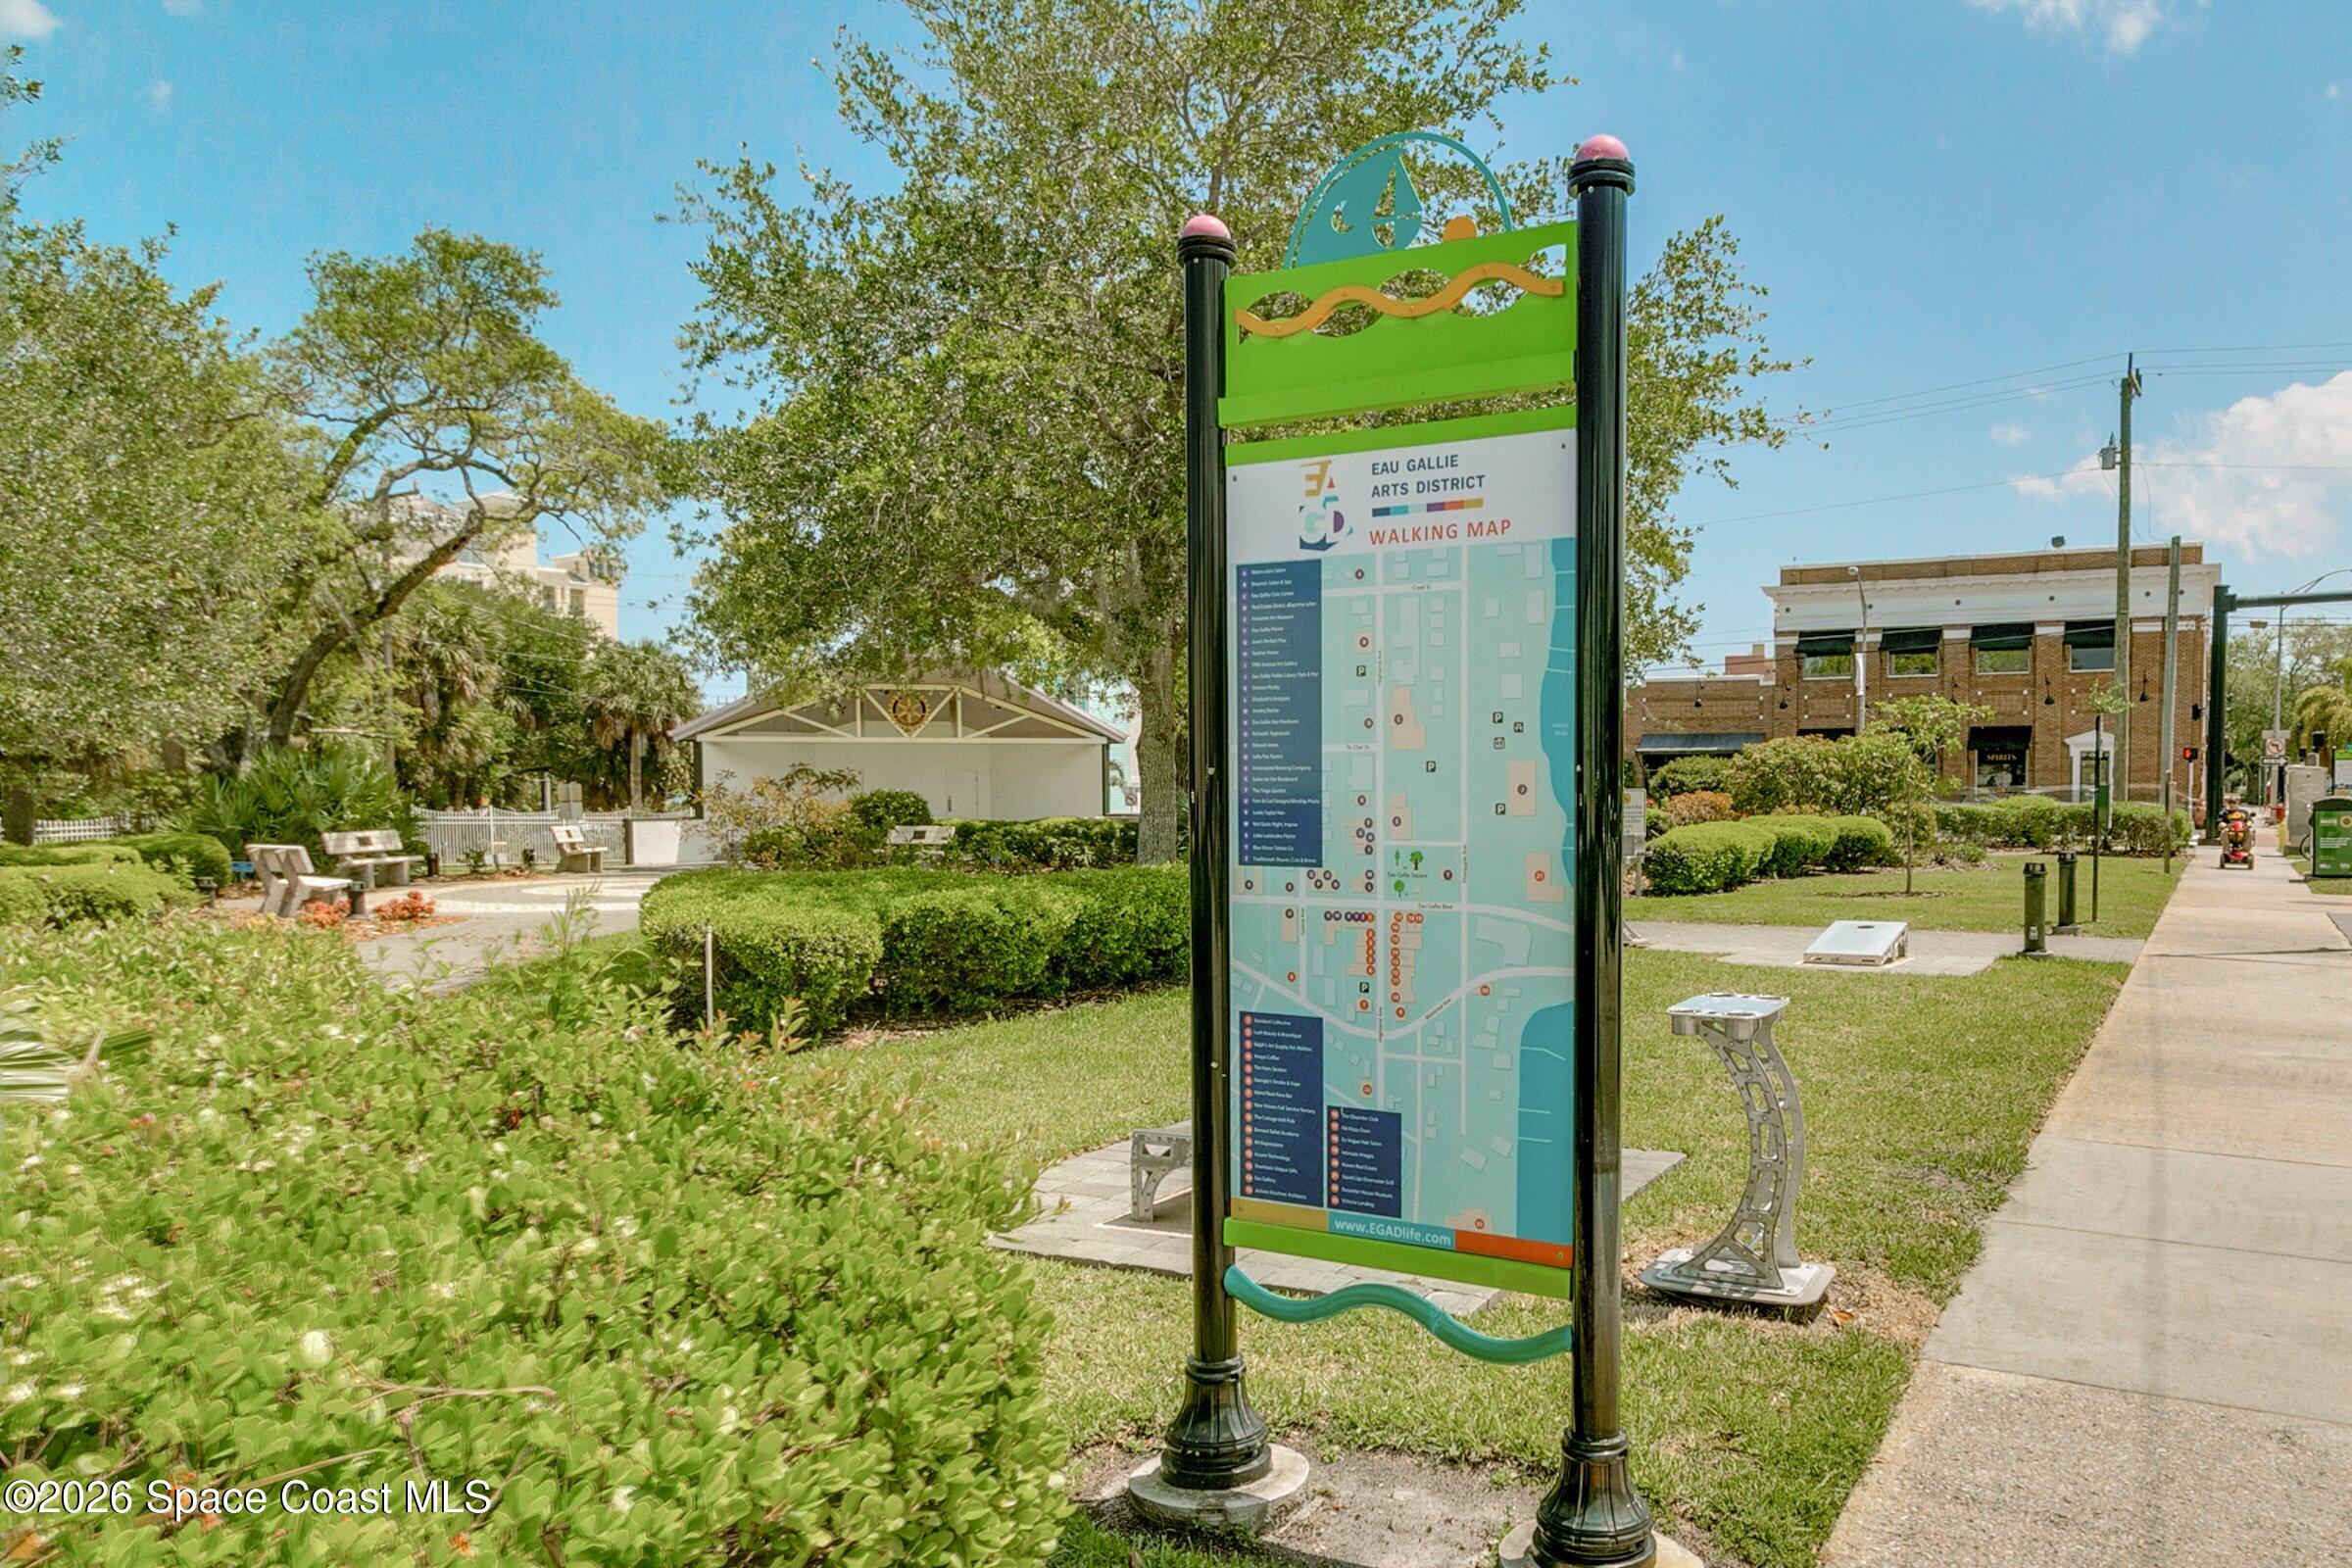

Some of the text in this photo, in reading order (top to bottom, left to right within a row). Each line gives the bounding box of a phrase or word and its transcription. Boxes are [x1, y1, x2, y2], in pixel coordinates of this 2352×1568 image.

[1372, 454, 1459, 475] EAU GALLIE
[1371, 474, 1486, 498] ARTS DISTRICT
[1369, 518, 1511, 545] WALKING MAP
[1334, 1219, 1451, 1247] www.EGADlife.com
